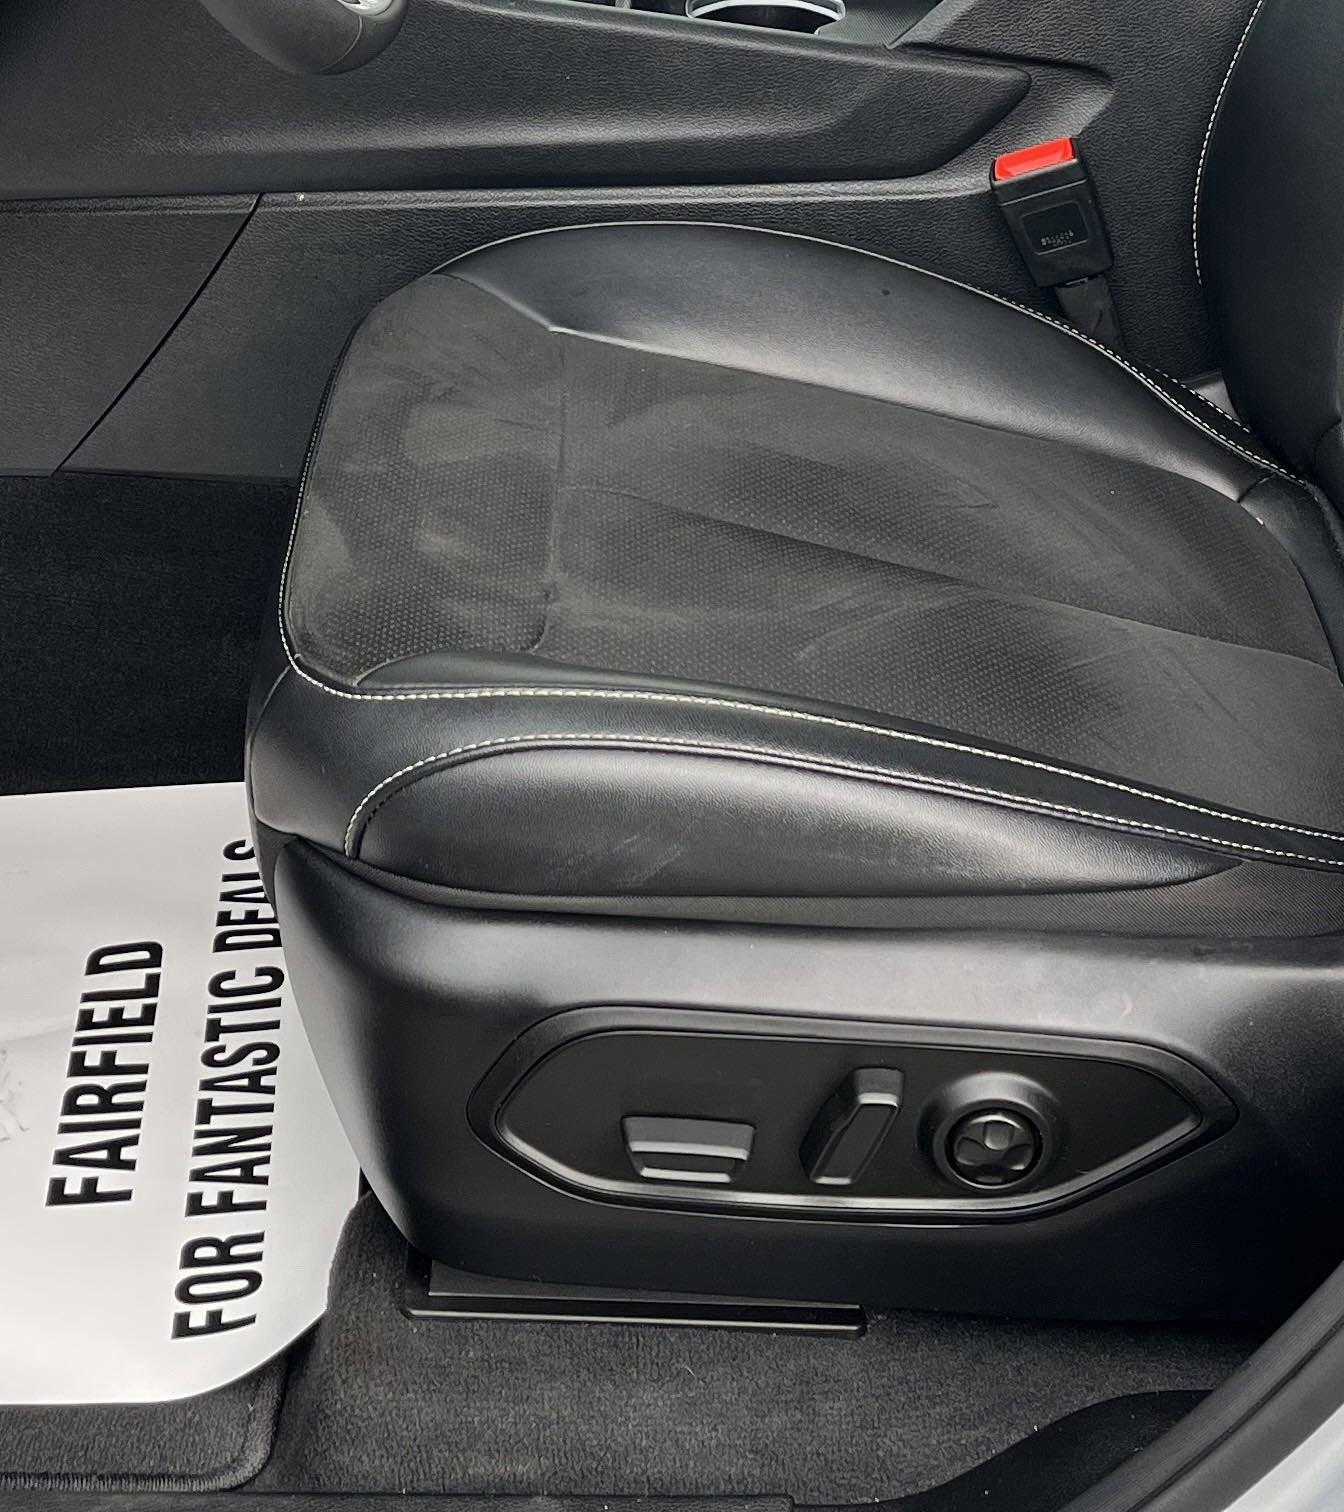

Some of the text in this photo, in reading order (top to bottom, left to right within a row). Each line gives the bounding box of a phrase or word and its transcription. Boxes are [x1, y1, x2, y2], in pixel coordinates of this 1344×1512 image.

[44, 940, 164, 1207] FAIRFIELD
[184, 965, 286, 1218] FANTASTIC
[170, 1230, 266, 1341] FOR
